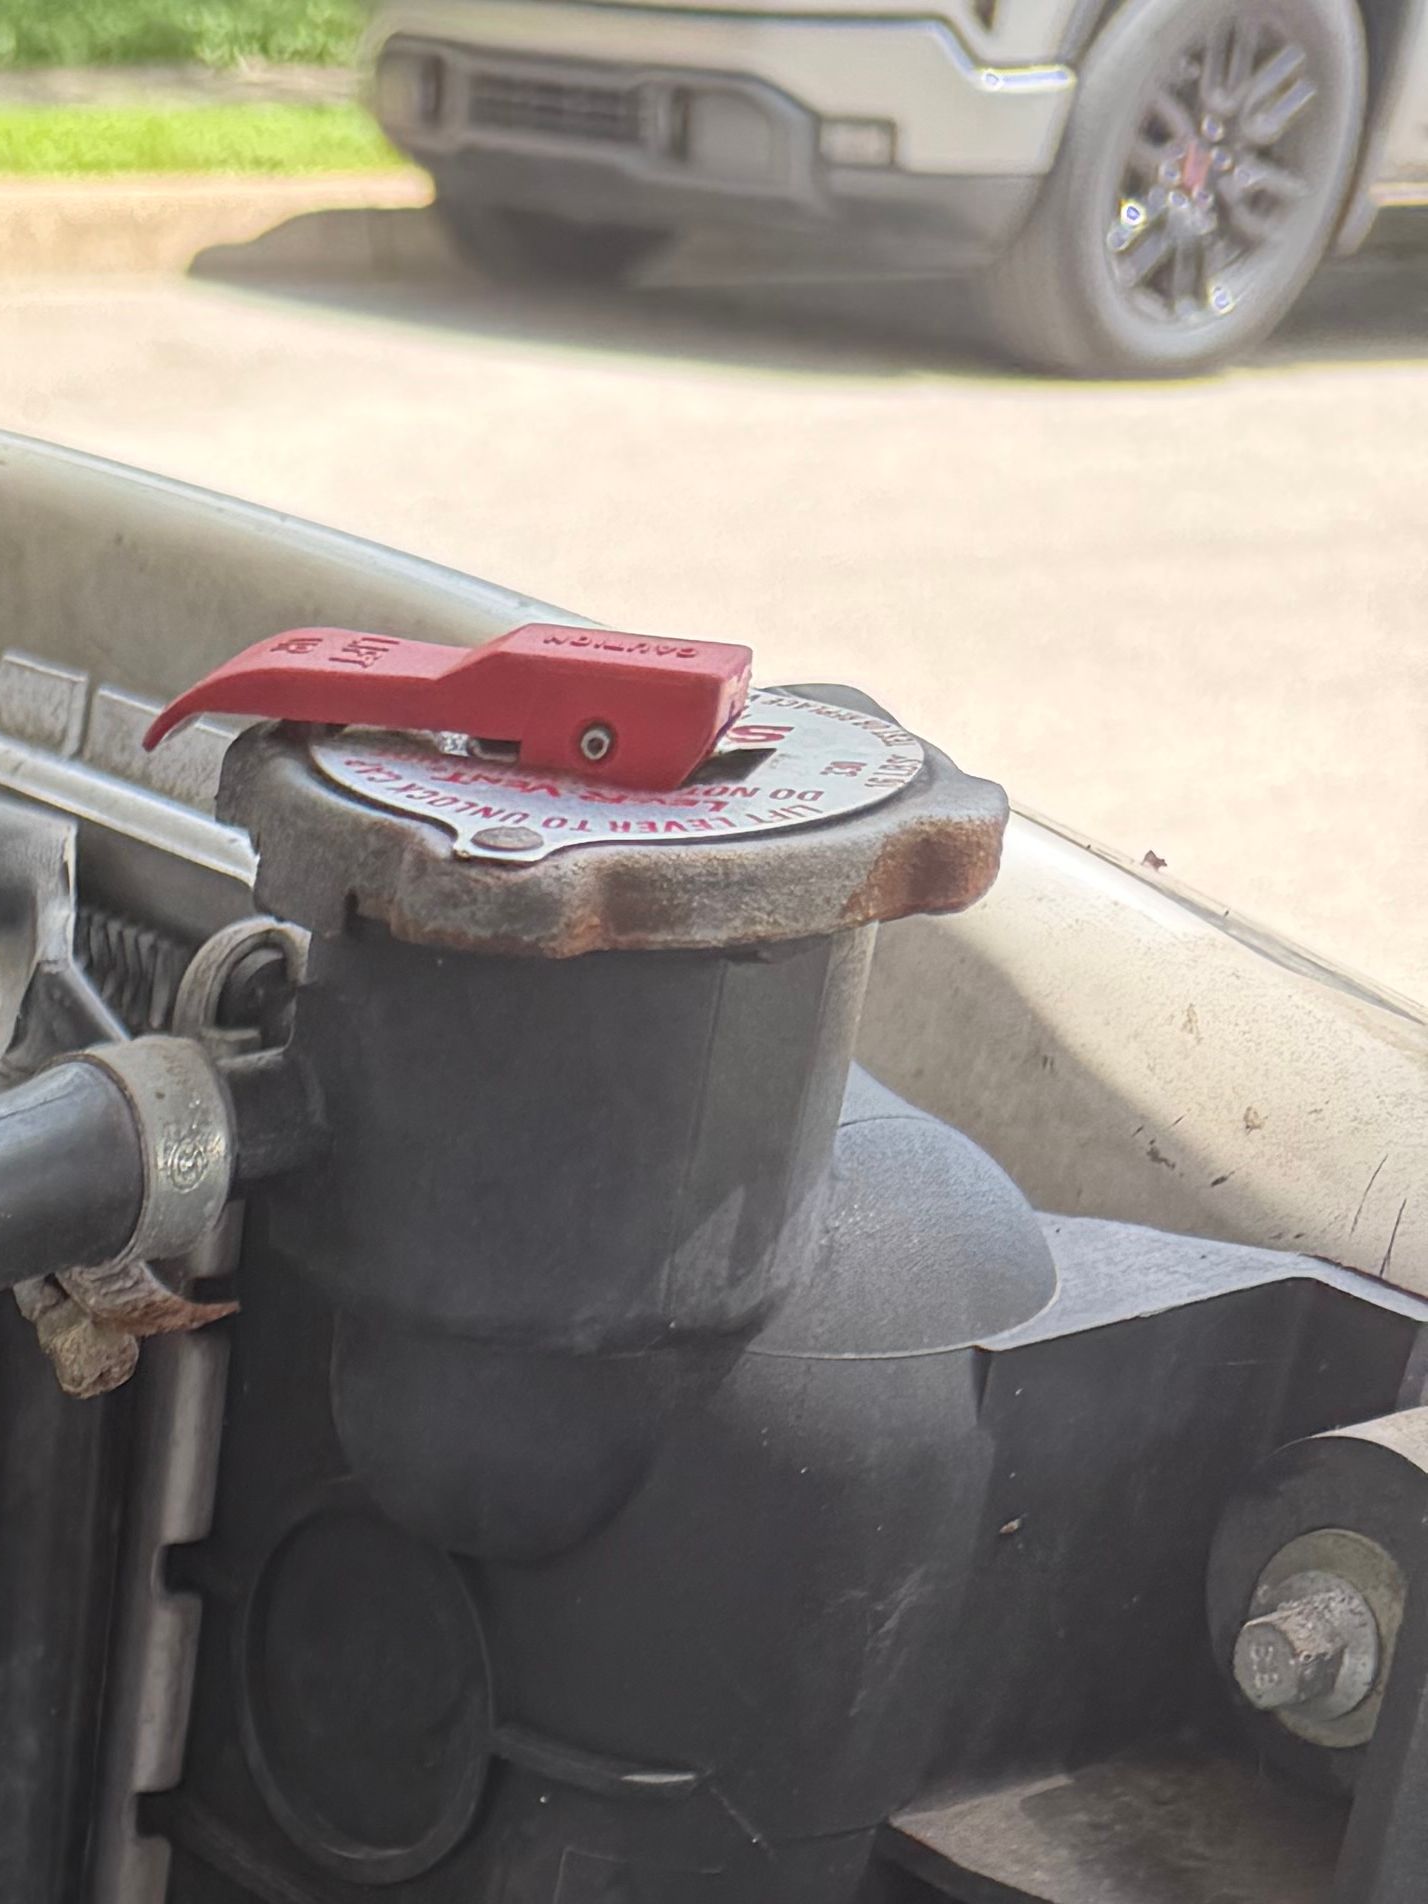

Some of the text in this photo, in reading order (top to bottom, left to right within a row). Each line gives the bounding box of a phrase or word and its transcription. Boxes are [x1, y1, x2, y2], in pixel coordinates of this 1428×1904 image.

[329, 636, 401, 668] LIFT
[543, 633, 700, 659] CAUTION
[345, 759, 403, 783] CAP
[386, 782, 531, 825] UNLOCK
[678, 785, 825, 801] DO NOT
[541, 816, 593, 833] TO
[608, 815, 738, 834] LEVER
[746, 803, 824, 824] LIFT
